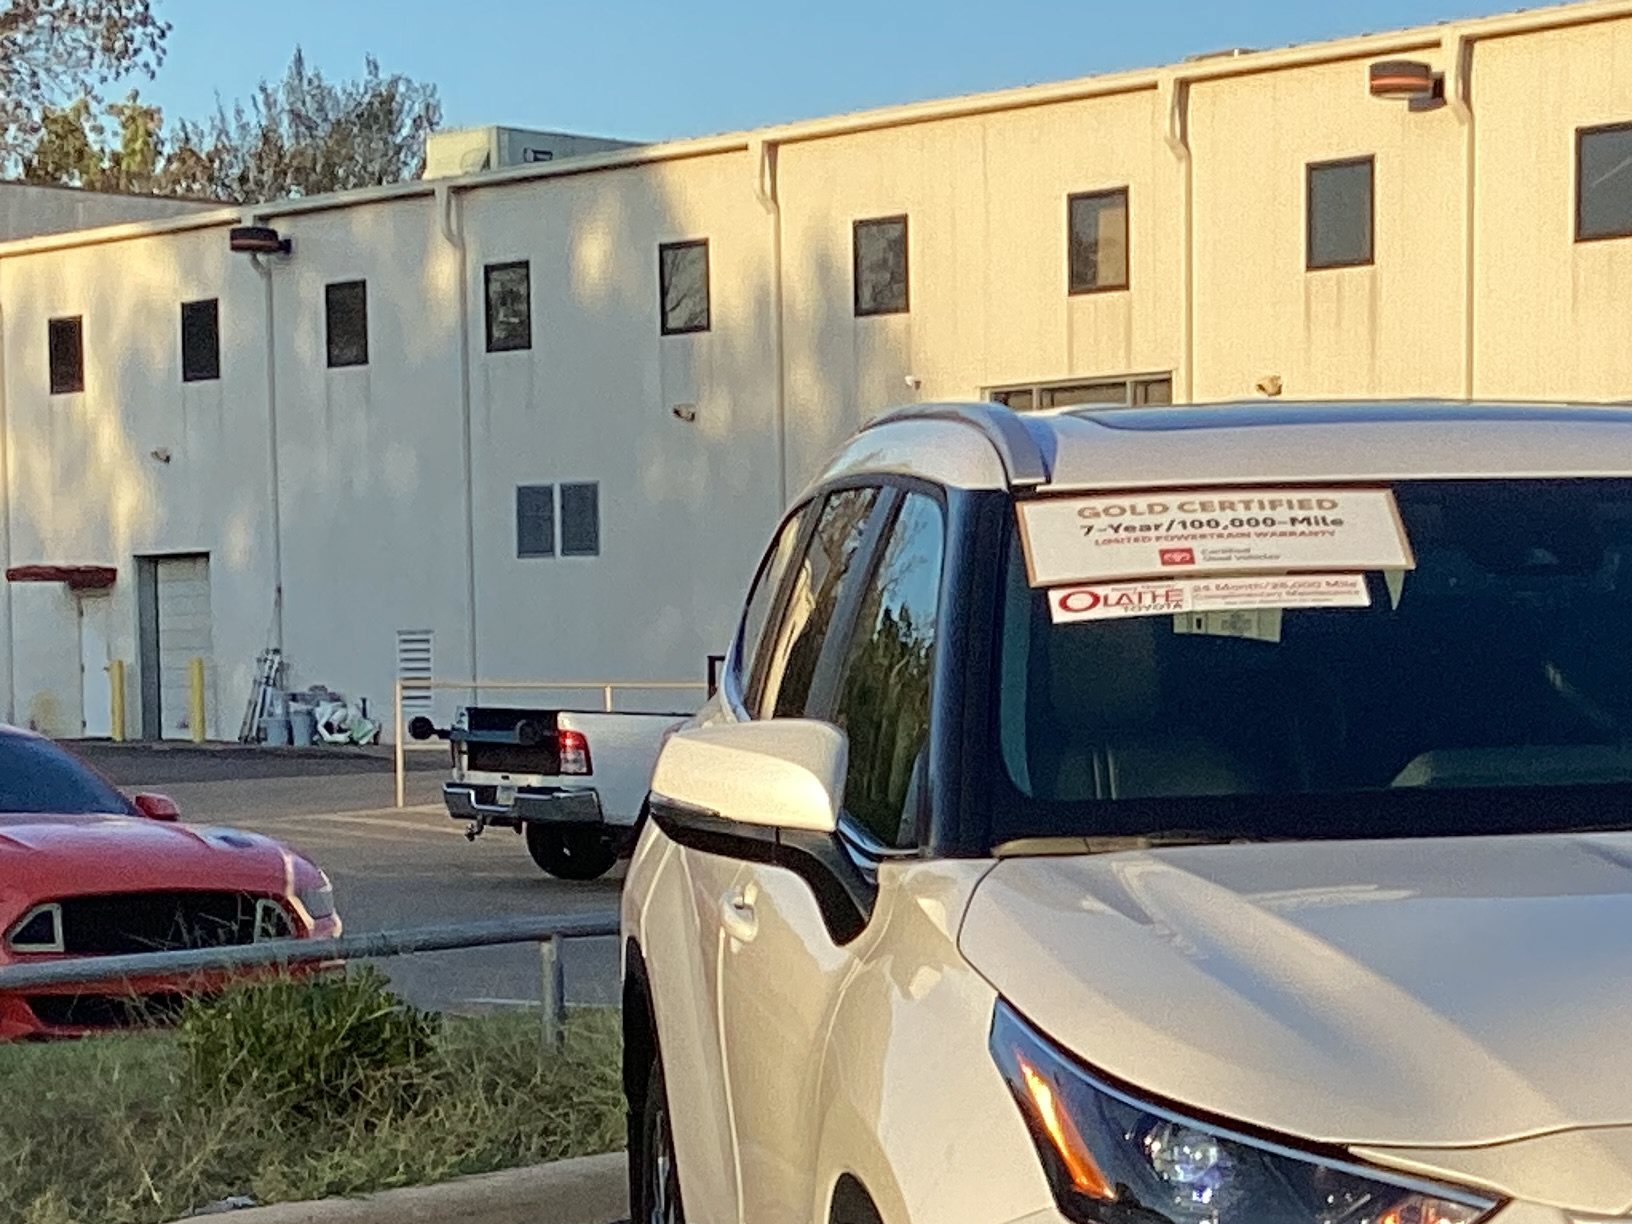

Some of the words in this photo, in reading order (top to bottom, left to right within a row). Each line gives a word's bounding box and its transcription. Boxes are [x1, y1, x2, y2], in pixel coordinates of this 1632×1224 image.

[1077, 502, 1170, 519] GOLD
[1177, 498, 1339, 514] CERTIFIED
[1079, 514, 1344, 537] 7-Year/100,000-Mile
